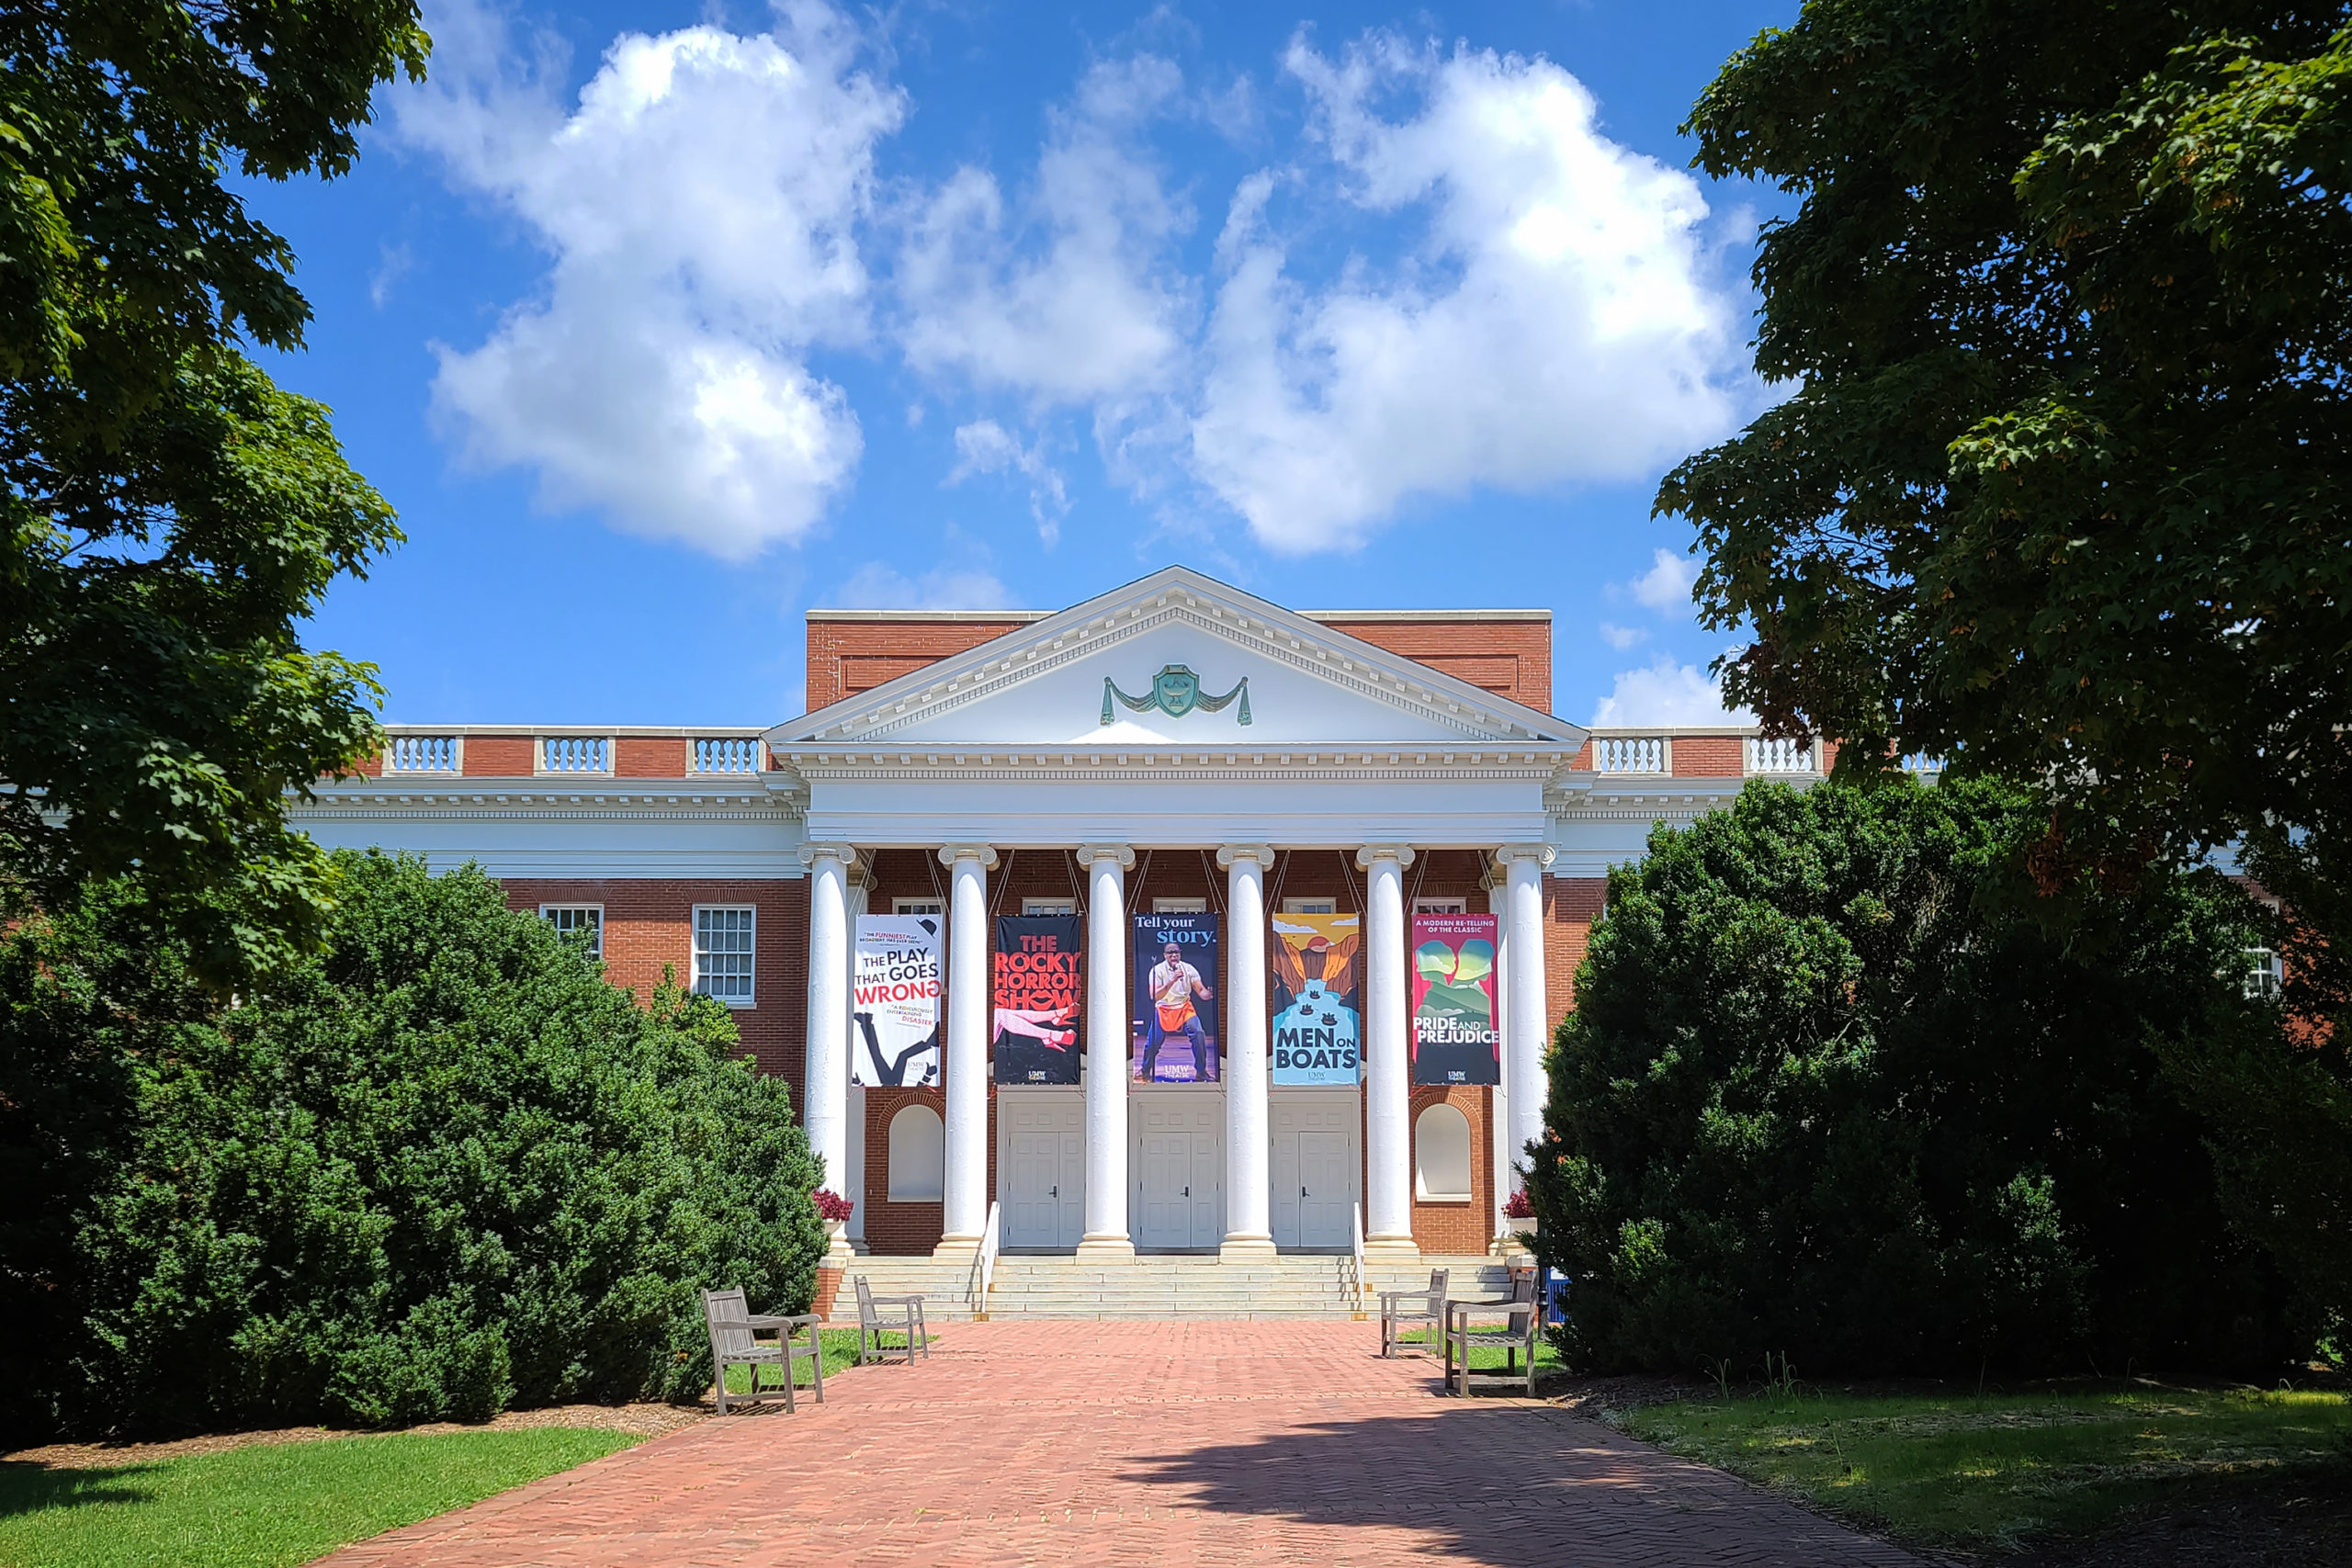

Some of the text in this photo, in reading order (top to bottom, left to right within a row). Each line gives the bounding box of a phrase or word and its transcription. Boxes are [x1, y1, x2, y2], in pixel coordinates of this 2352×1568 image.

[1135, 916, 1195, 930] Tell your
[1020, 935, 1057, 952] THE
[1157, 929, 1217, 947] story.
[864, 947, 929, 967] THE PLAY
[994, 952, 1081, 973] ROCKY
[854, 963, 939, 985] THAT GOES
[994, 973, 1081, 989] HORROR
[854, 979, 941, 1005] WRONG
[1413, 1017, 1481, 1030] PRIDE AND
[1276, 1028, 1356, 1047] MEN ON
[1417, 1030, 1499, 1043] PREJUDICE
[1276, 1049, 1357, 1069] BOATS
[1164, 1065, 1190, 1073] UMW
